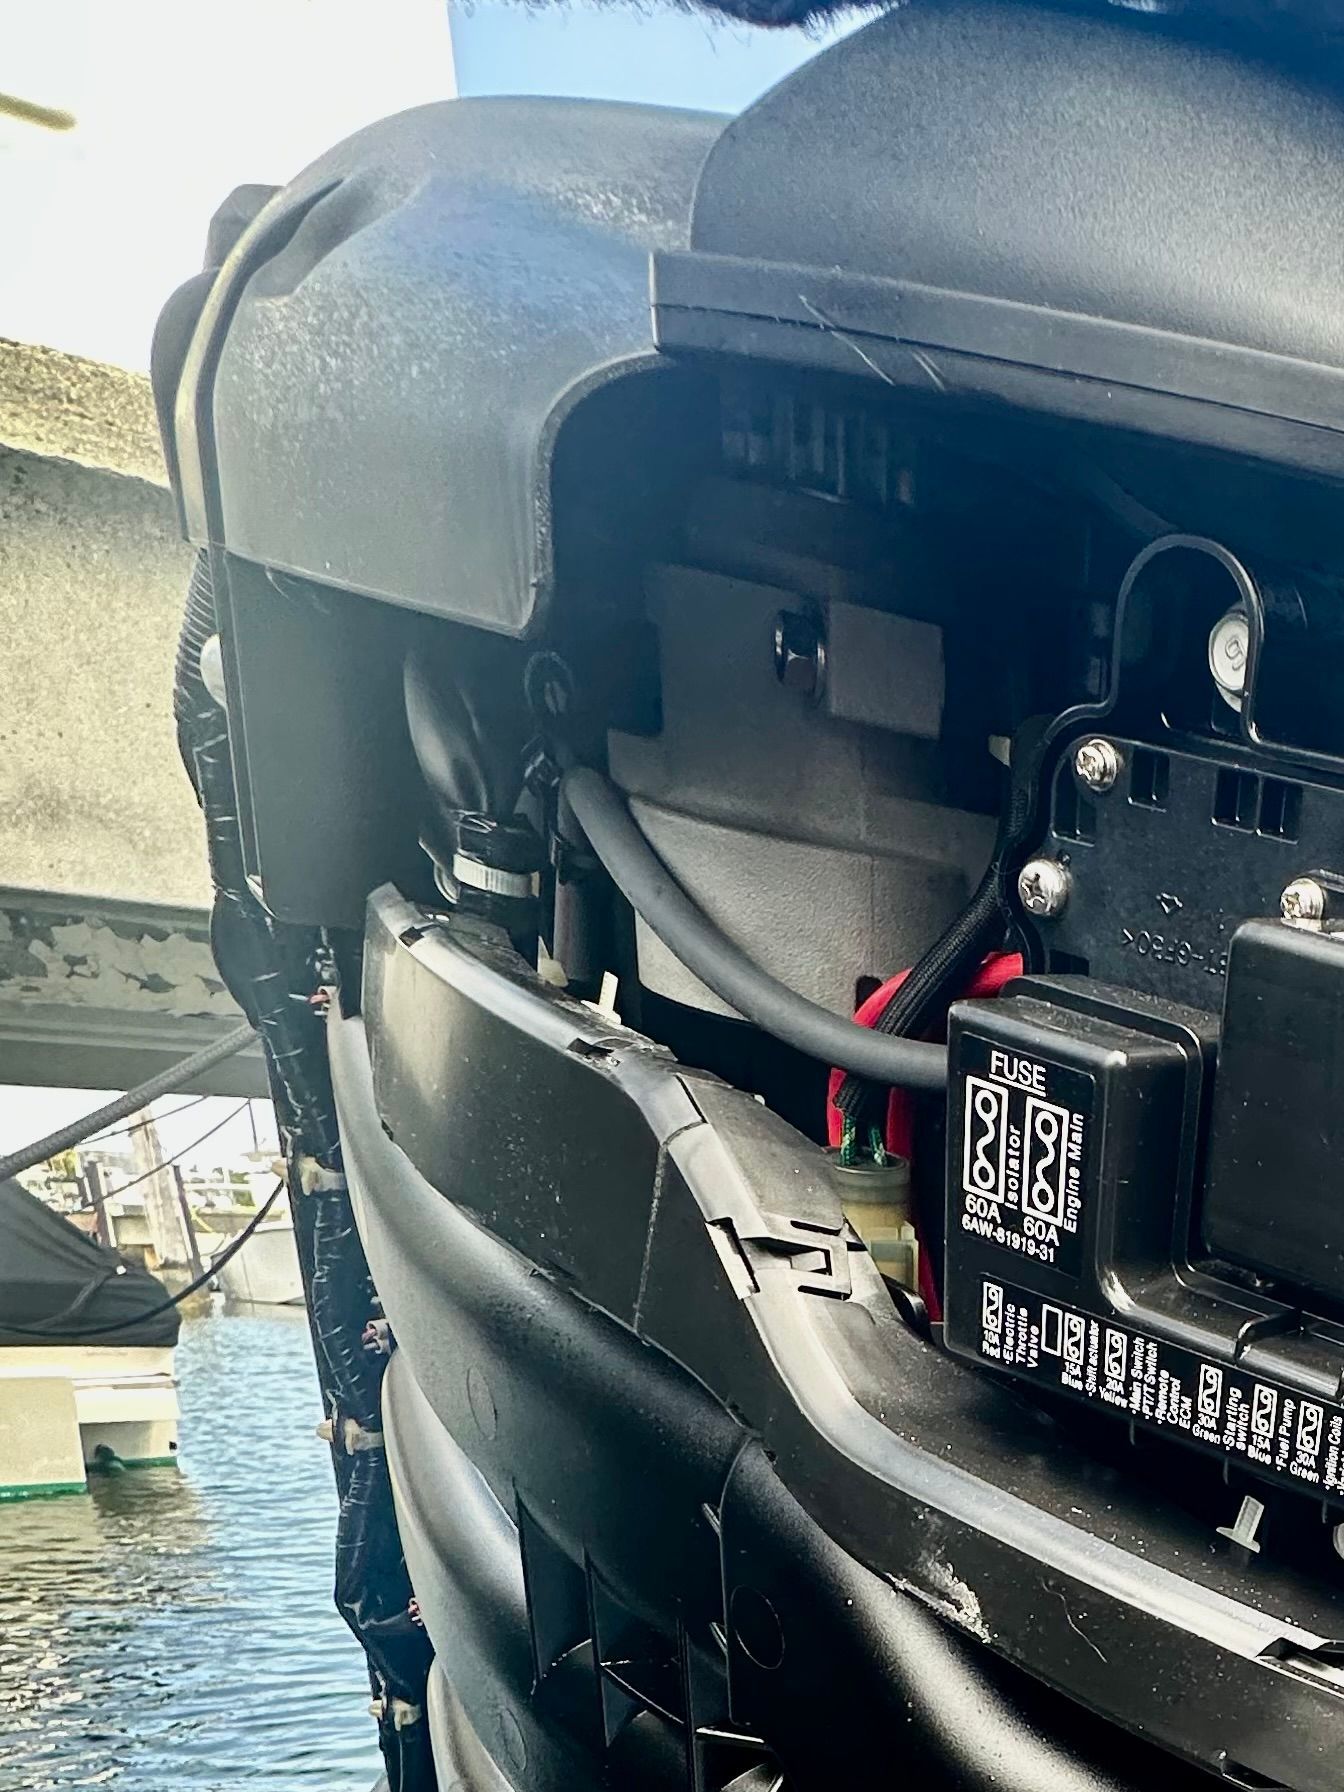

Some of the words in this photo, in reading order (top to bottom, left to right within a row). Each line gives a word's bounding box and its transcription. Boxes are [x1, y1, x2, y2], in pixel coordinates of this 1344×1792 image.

[991, 1050, 1046, 1090] FUSE
[1068, 1113, 1084, 1161] Main
[1004, 1123, 1021, 1210] Isolator
[965, 1194, 1002, 1224] 60A
[1063, 1166, 1082, 1233] Engine
[961, 1213, 1055, 1262] 6AW-81919-31
[1023, 1216, 1060, 1247] 60A
[983, 1330, 1000, 1347] 10A
[1002, 1303, 1016, 1362] Electric
[1015, 1307, 1028, 1364] Throttle
[1027, 1325, 1039, 1368] Valve
[1064, 1361, 1082, 1378] 15A
[1131, 1337, 1145, 1380] Switch
[1144, 1341, 1158, 1385] Switch
[1099, 1386, 1128, 1408] Yellow
[1106, 1377, 1124, 1395] 20A
[1142, 1384, 1155, 1416] PT/T
[1155, 1370, 1169, 1421] Remote
[1167, 1377, 1181, 1424] Control
[1179, 1396, 1193, 1429] ECM
[1198, 1413, 1217, 1430] 30A
[1223, 1387, 1242, 1447] Starting
[1279, 1399, 1296, 1437] Pump
[1328, 1415, 1343, 1445] Coils
[1192, 1424, 1220, 1444] Green
[1252, 1434, 1271, 1451] 15A
[1275, 1436, 1290, 1468] Fuel
[1296, 1450, 1316, 1469] 30A
[1323, 1445, 1339, 1487] Ignition
[1289, 1461, 1320, 1483] Green
